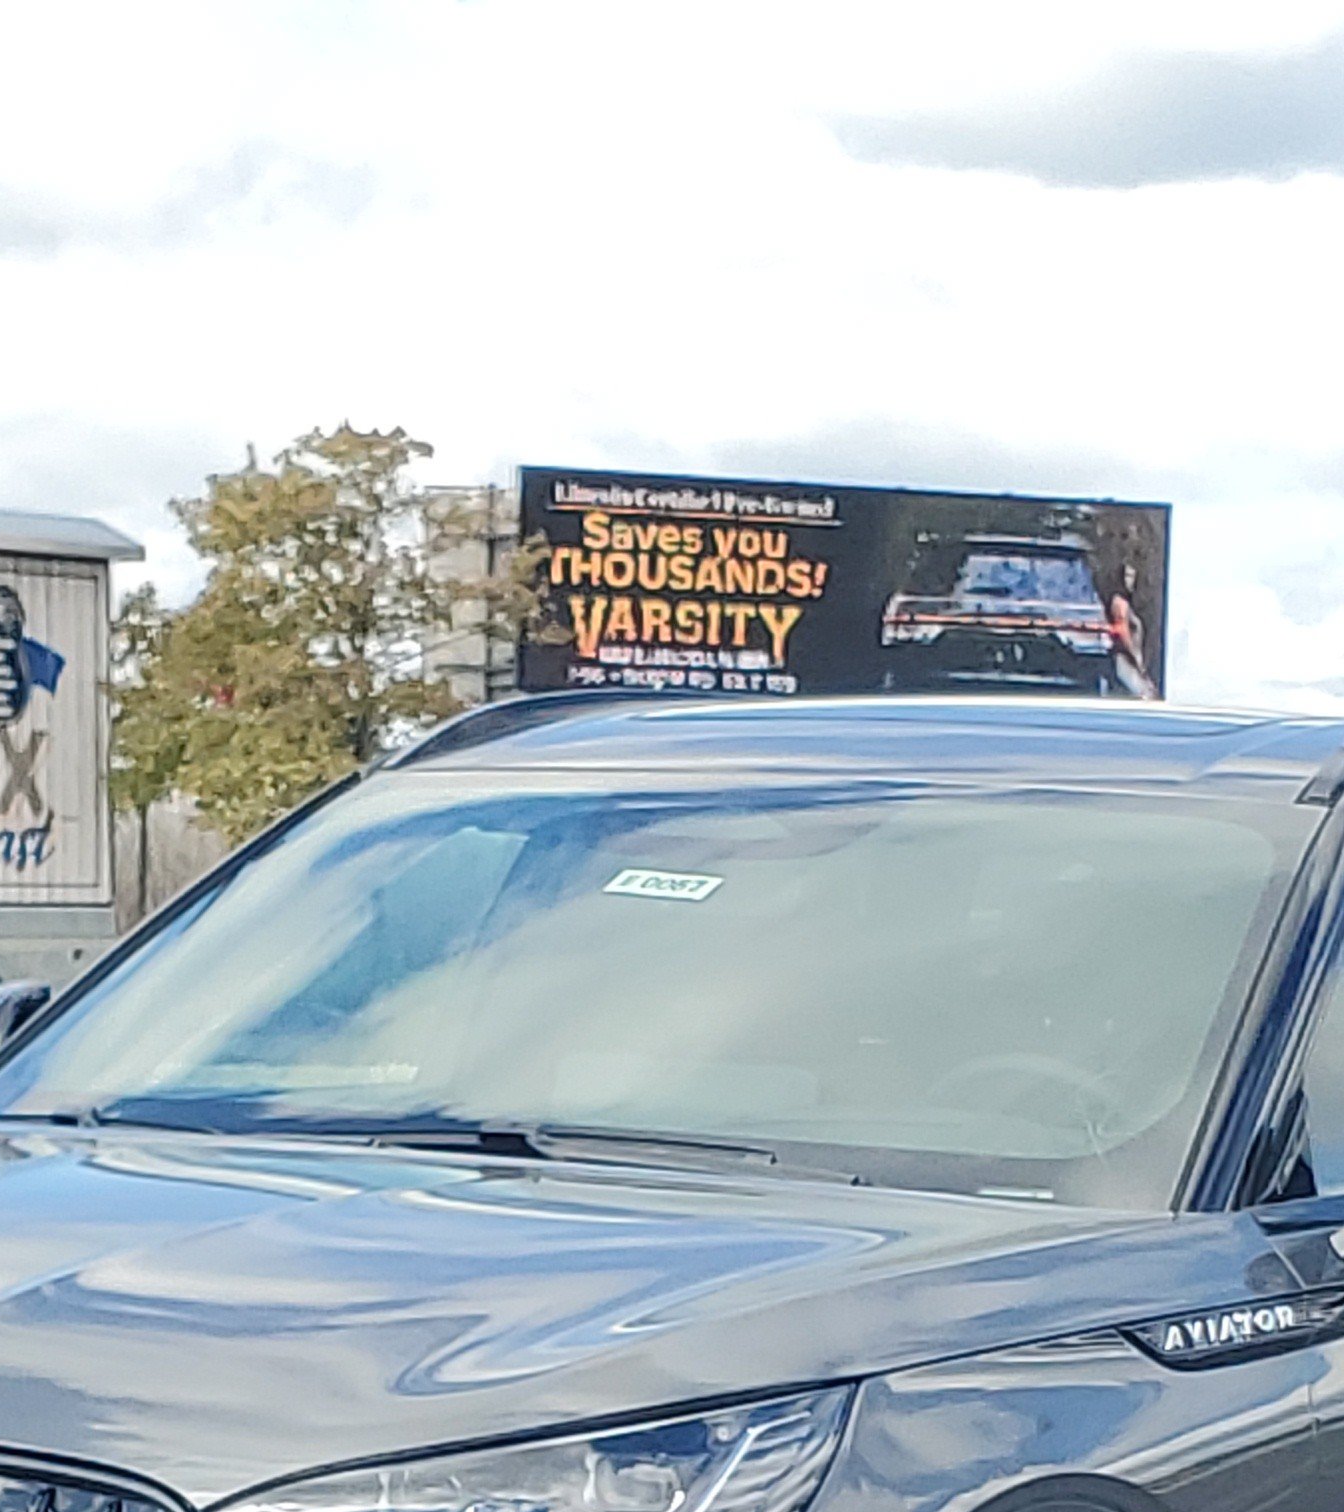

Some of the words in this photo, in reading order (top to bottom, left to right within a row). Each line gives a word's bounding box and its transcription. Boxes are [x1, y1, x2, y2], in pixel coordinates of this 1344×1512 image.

[582, 511, 703, 555] Saves
[712, 529, 788, 560] you
[550, 547, 828, 599] THOUSANDS!
[568, 595, 802, 668] VARSITY
[1164, 1305, 1294, 1350] AVIATOR
